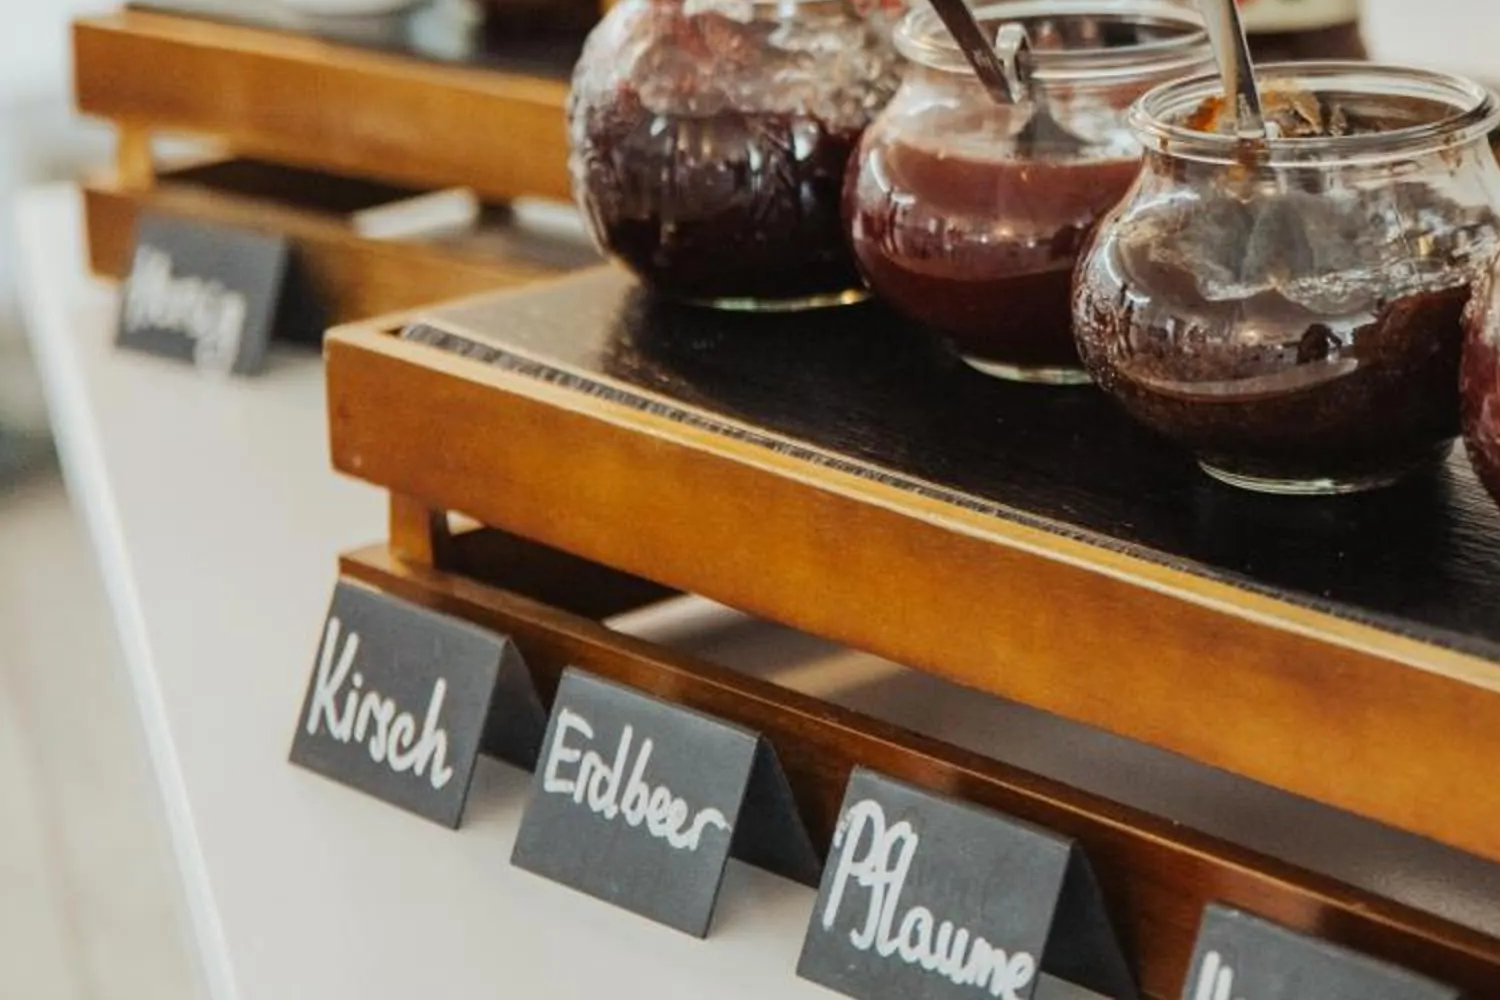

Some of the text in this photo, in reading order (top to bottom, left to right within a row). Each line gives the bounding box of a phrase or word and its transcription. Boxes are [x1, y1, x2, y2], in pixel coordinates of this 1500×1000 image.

[307, 617, 453, 790] Kirsch
[544, 709, 732, 850] Erdbeer
[823, 799, 1035, 1000] Pflaume
